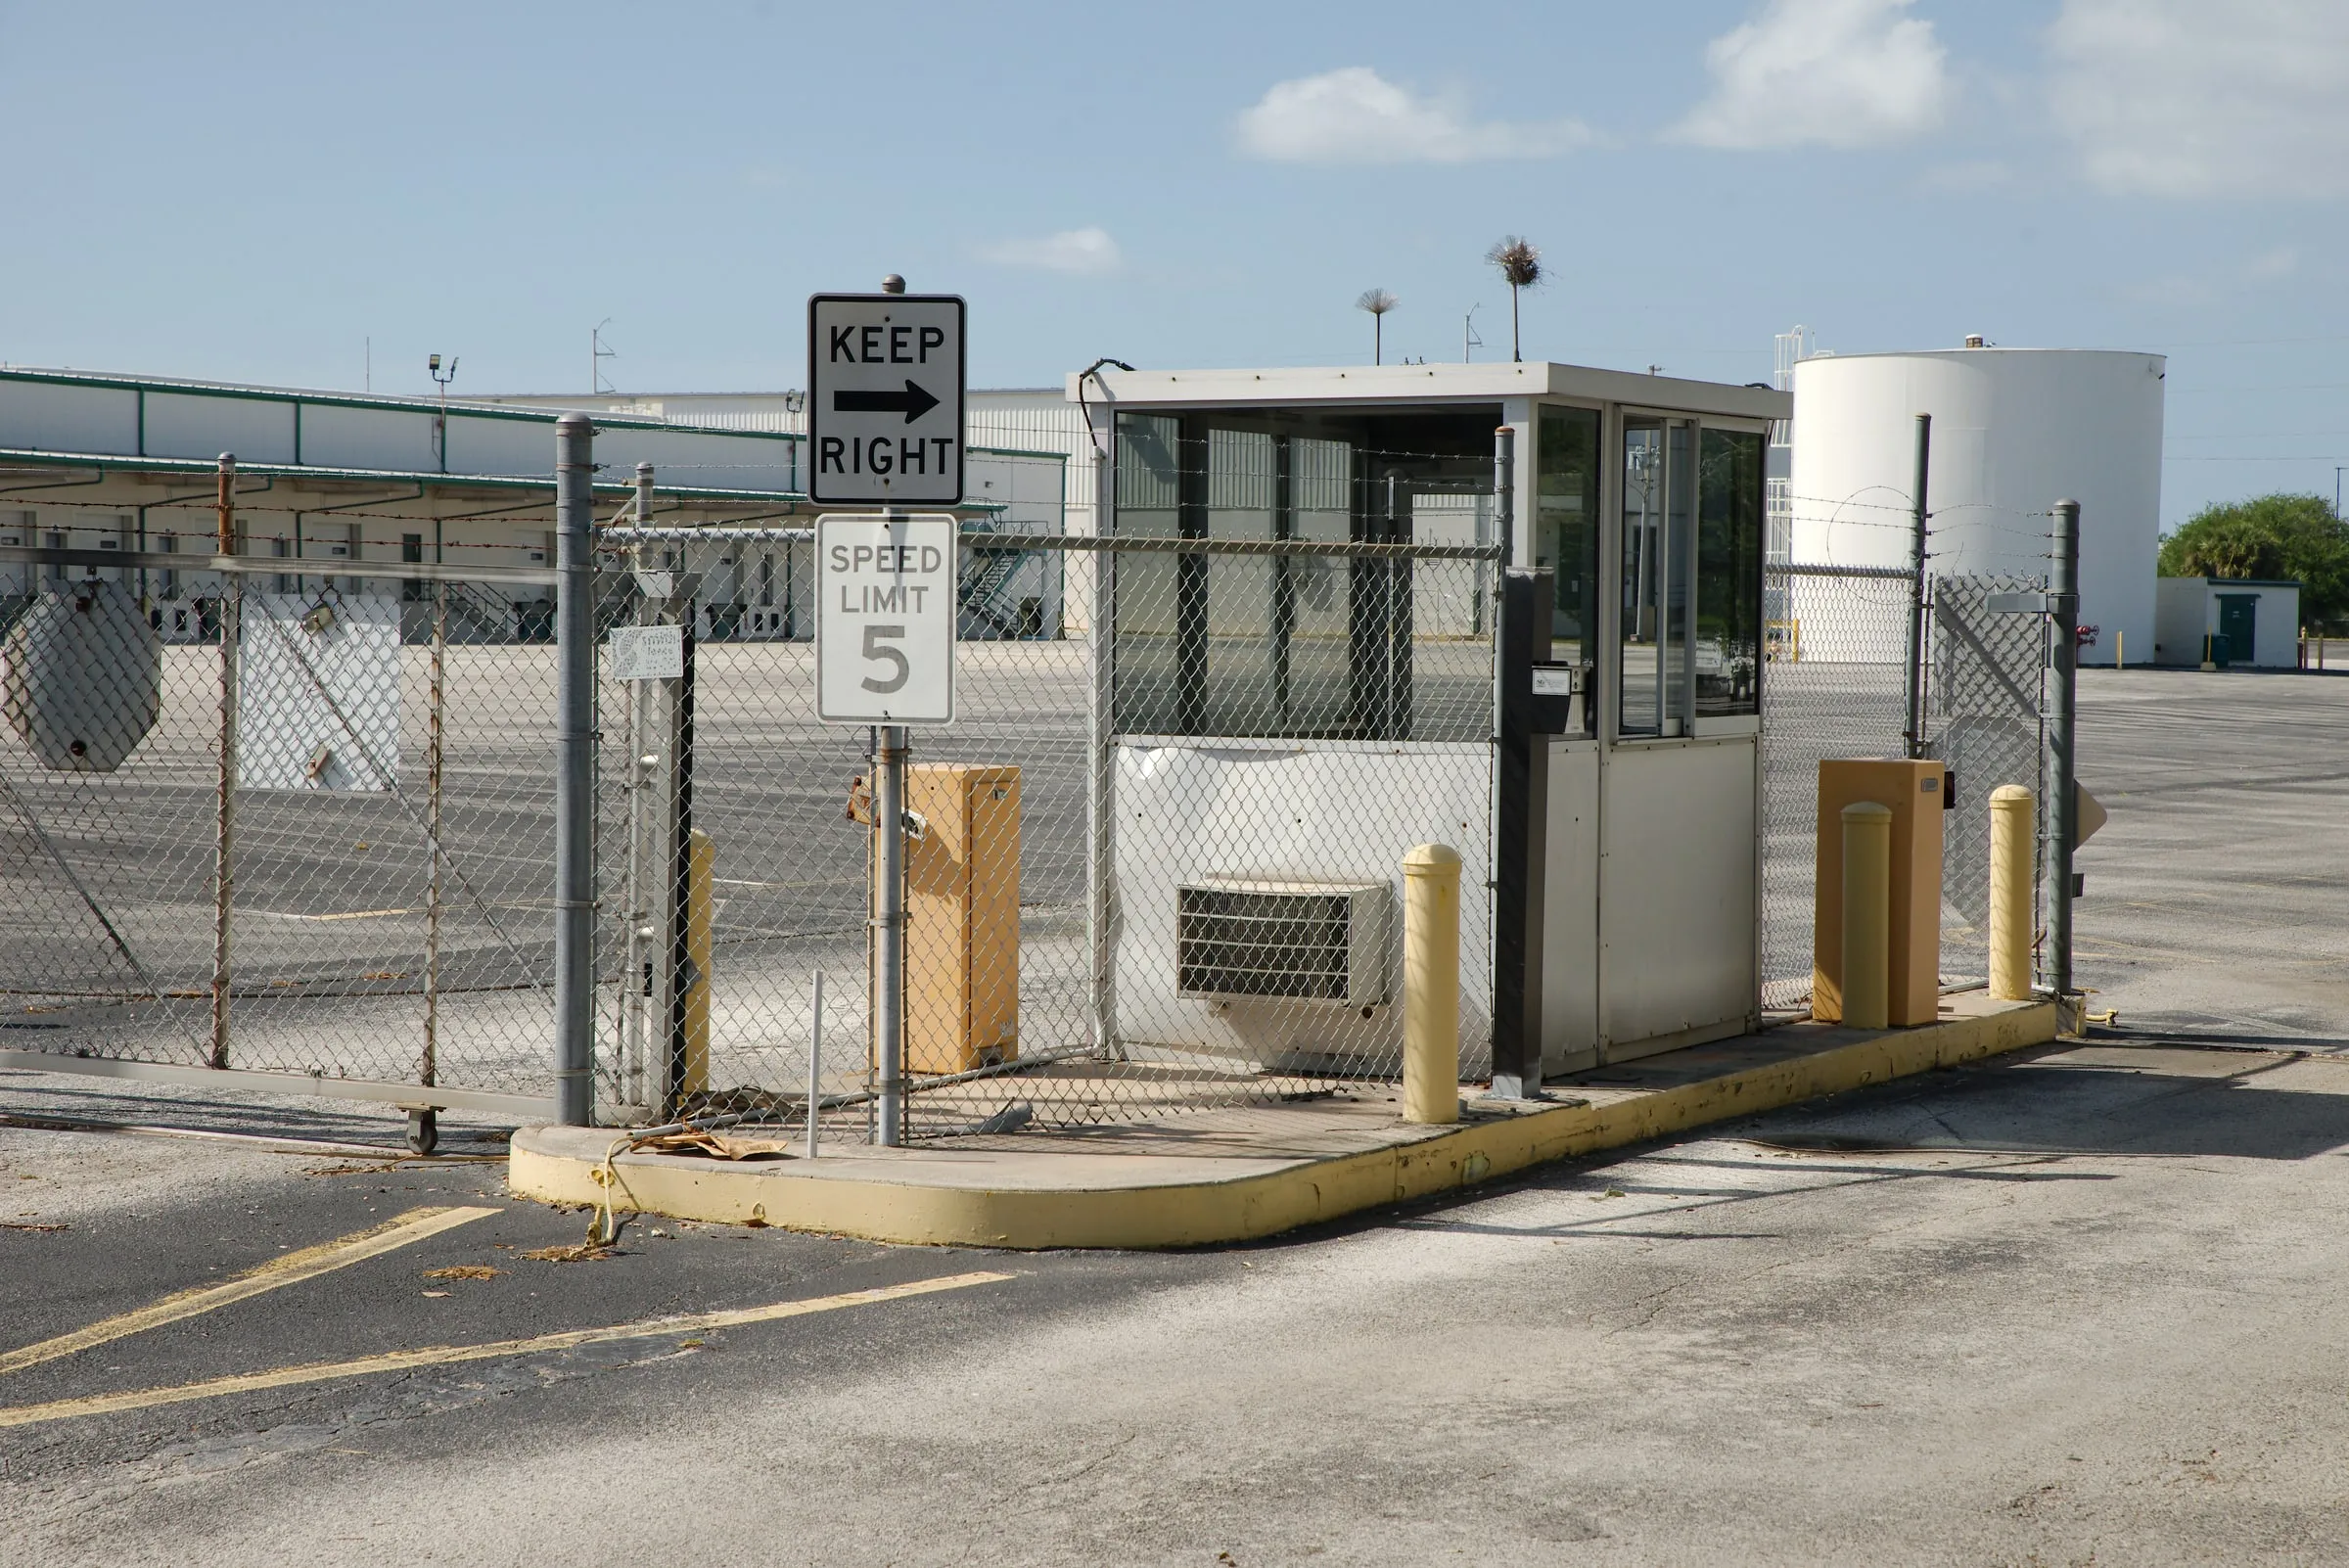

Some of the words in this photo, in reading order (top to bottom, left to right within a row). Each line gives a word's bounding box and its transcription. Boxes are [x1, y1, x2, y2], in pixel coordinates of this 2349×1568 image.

[830, 325, 944, 363] KEEP
[820, 437, 953, 474] RIGHT
[830, 545, 942, 573] SPEED
[841, 585, 929, 614] LIMIT
[860, 624, 909, 694] 5
